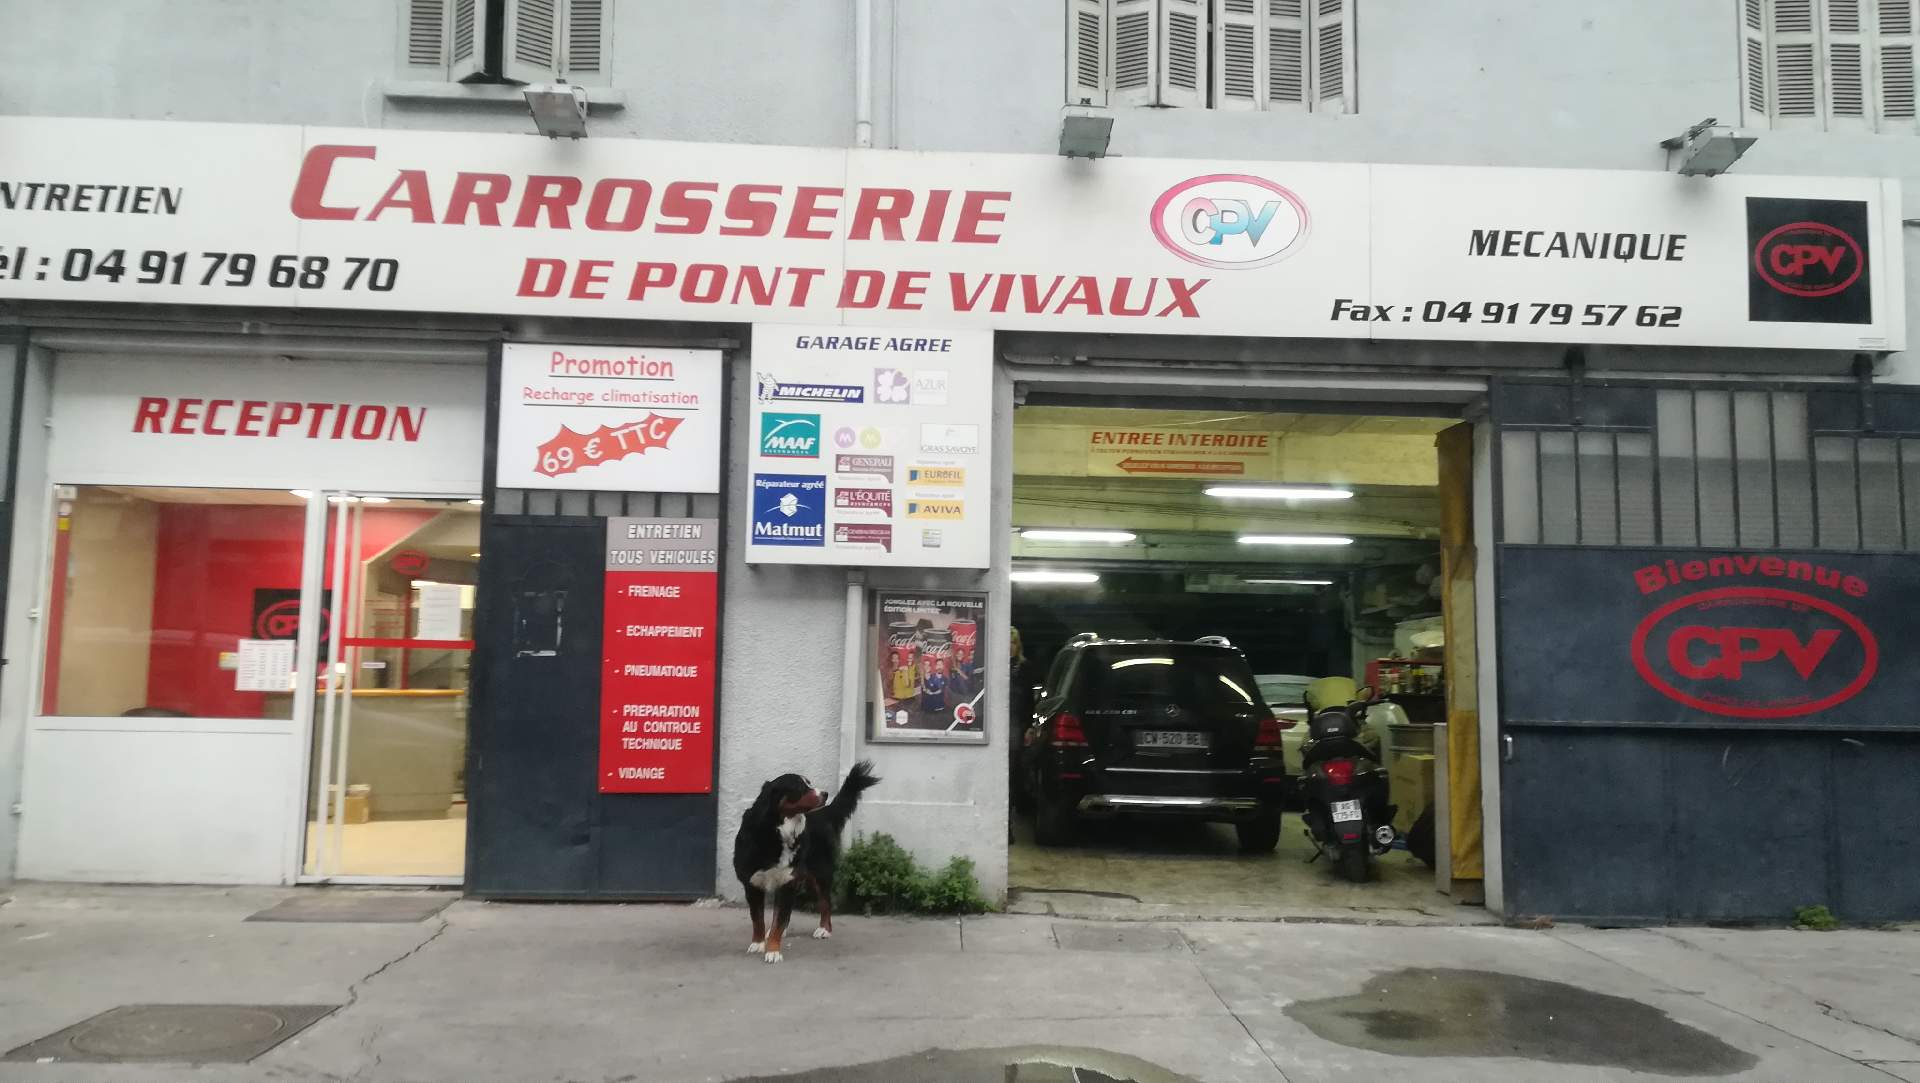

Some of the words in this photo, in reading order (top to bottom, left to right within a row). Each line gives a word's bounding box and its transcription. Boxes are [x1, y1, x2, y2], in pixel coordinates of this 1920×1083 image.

[291, 145, 1012, 244] CARROSSERIE
[1181, 197, 1281, 248] CPV
[1468, 230, 1688, 264] MECANIQUE
[1770, 244, 1846, 275] CPV
[62, 248, 126, 284] 04
[137, 250, 187, 285] 91
[200, 252, 257, 287] 79
[268, 255, 330, 290] 68
[343, 257, 400, 292] 70
[517, 258, 614, 300] DE
[628, 262, 825, 308] PONT
[839, 269, 931, 311] DE
[950, 272, 1209, 318] VIVAUX
[1330, 298, 1396, 322] Fax
[1422, 301, 1473, 323] 04
[1481, 302, 1520, 325] 91
[1529, 303, 1574, 326] 79
[1581, 304, 1628, 327] 57
[1635, 305, 1683, 328] 62
[796, 336, 881, 350] GARAGE
[884, 338, 952, 352] AGREE
[551, 351, 673, 377] Promotion
[523, 387, 594, 404] Recharge
[602, 389, 699, 405] climatisation
[779, 386, 861, 399] MICHELIN
[133, 397, 426, 442] RECEPTION
[542, 446, 574, 473] 69
[583, 437, 603, 459] €
[611, 418, 667, 450] TTC
[767, 436, 815, 449] MAAF
[1091, 431, 1164, 446] ENTREE
[1168, 434, 1268, 448] INTERDITE
[851, 457, 891, 467] GENERALI
[924, 471, 961, 480] EUROFIL
[755, 479, 800, 489] Réparateur
[801, 481, 824, 491] agréé
[923, 506, 961, 514] AVIVA
[627, 524, 701, 539] ENTRETIEN
[754, 522, 823, 536] Matmut
[610, 550, 644, 564] TOUS
[650, 550, 716, 564] VEHICULES
[1633, 555, 1868, 598] Bienvenue
[628, 585, 680, 598] FREINAGE
[626, 625, 704, 638] ECHAPPEMENT
[1667, 625, 1841, 681] CPV
[624, 664, 698, 678] PNEUMATIQUE
[622, 704, 700, 718] PREPARATION
[622, 721, 638, 733] AU
[643, 721, 701, 734] CONTROLE
[622, 738, 682, 751] TECHNIQUE
[618, 767, 665, 780] VIDANGE
